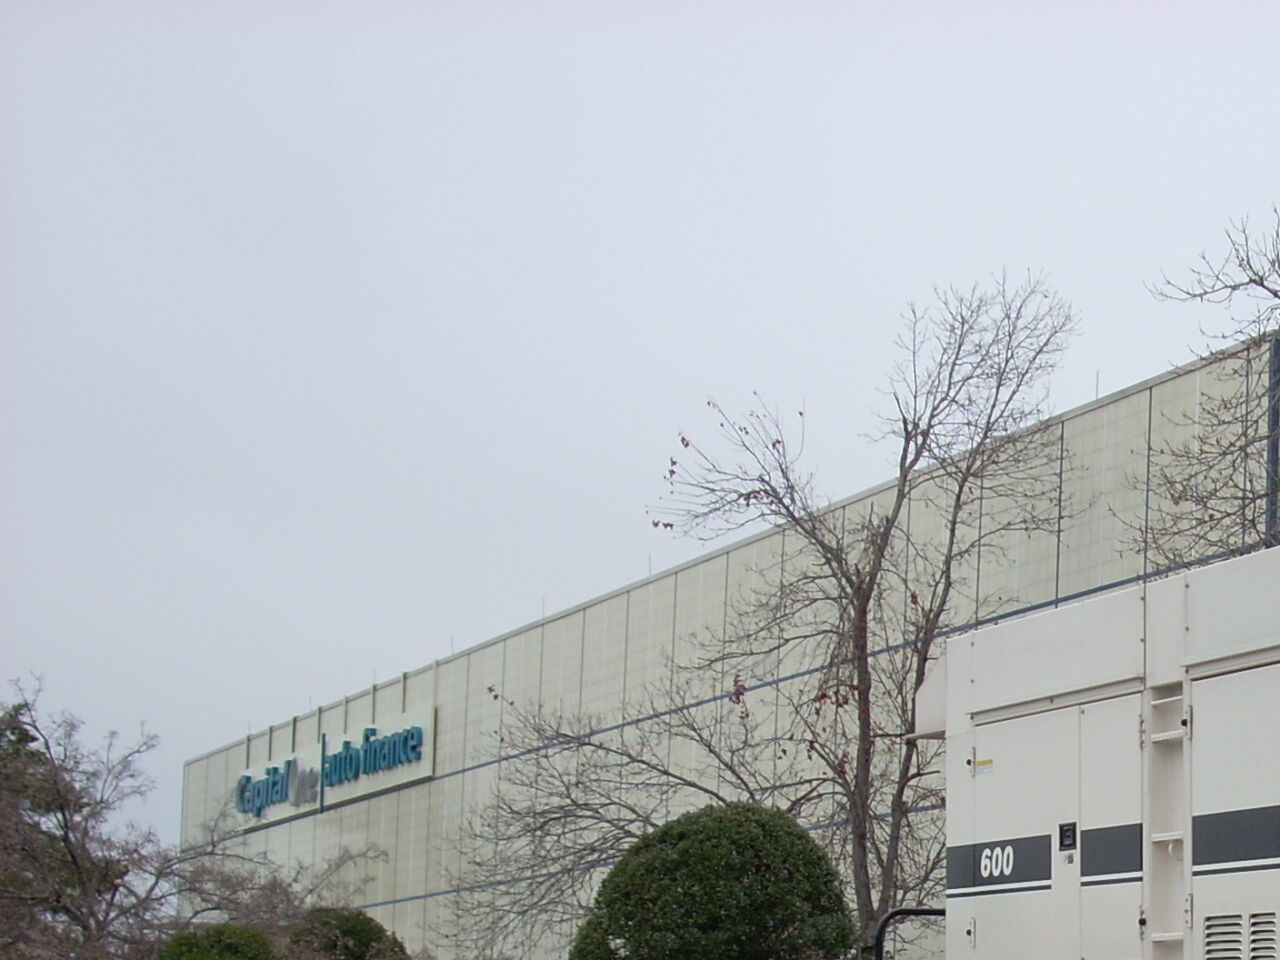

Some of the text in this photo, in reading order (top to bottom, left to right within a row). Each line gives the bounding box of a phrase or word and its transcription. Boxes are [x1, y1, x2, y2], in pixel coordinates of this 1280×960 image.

[235, 759, 289, 818] Capital
[324, 740, 361, 788] auto
[361, 726, 423, 775] finance
[980, 845, 1014, 878] 600
